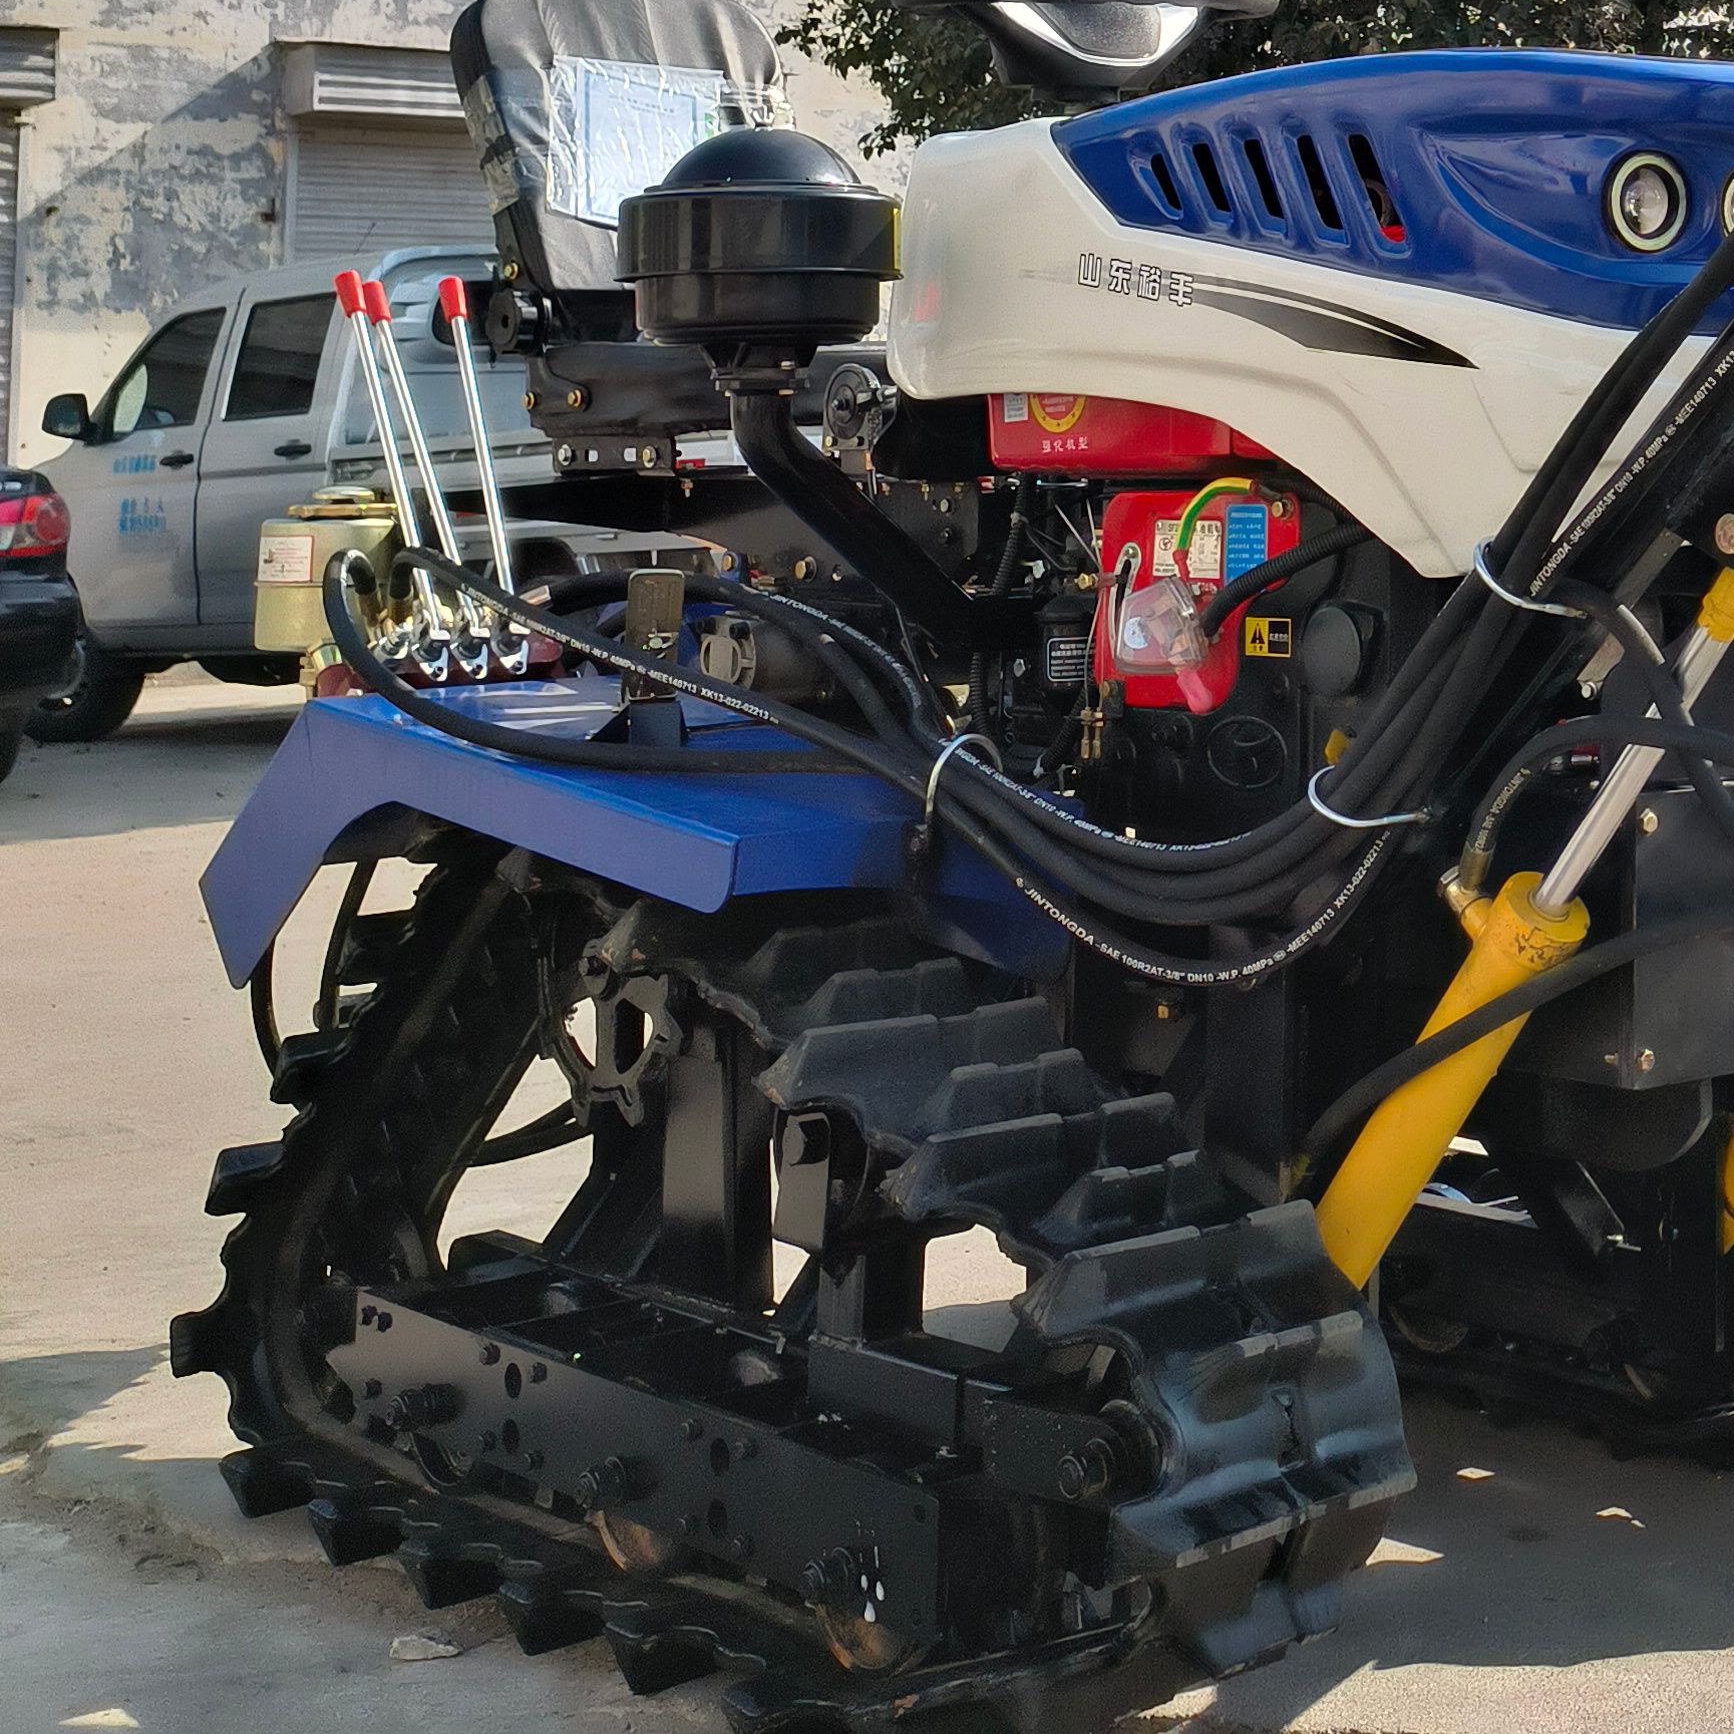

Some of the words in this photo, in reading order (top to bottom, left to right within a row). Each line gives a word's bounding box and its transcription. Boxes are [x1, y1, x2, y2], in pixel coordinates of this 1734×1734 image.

[1078, 252, 1194, 307] 山东裕丰
[1529, 542, 1572, 597] JINTONGDA
[769, 593, 829, 620] JINTONGDA
[700, 687, 769, 720] XK13-022-02213
[1024, 888, 1094, 946] JINTONGDA
[1187, 973, 1214, 983] DN10
[1242, 957, 1273, 976] 40MPa
[1333, 839, 1384, 910] XK13-022-02213
